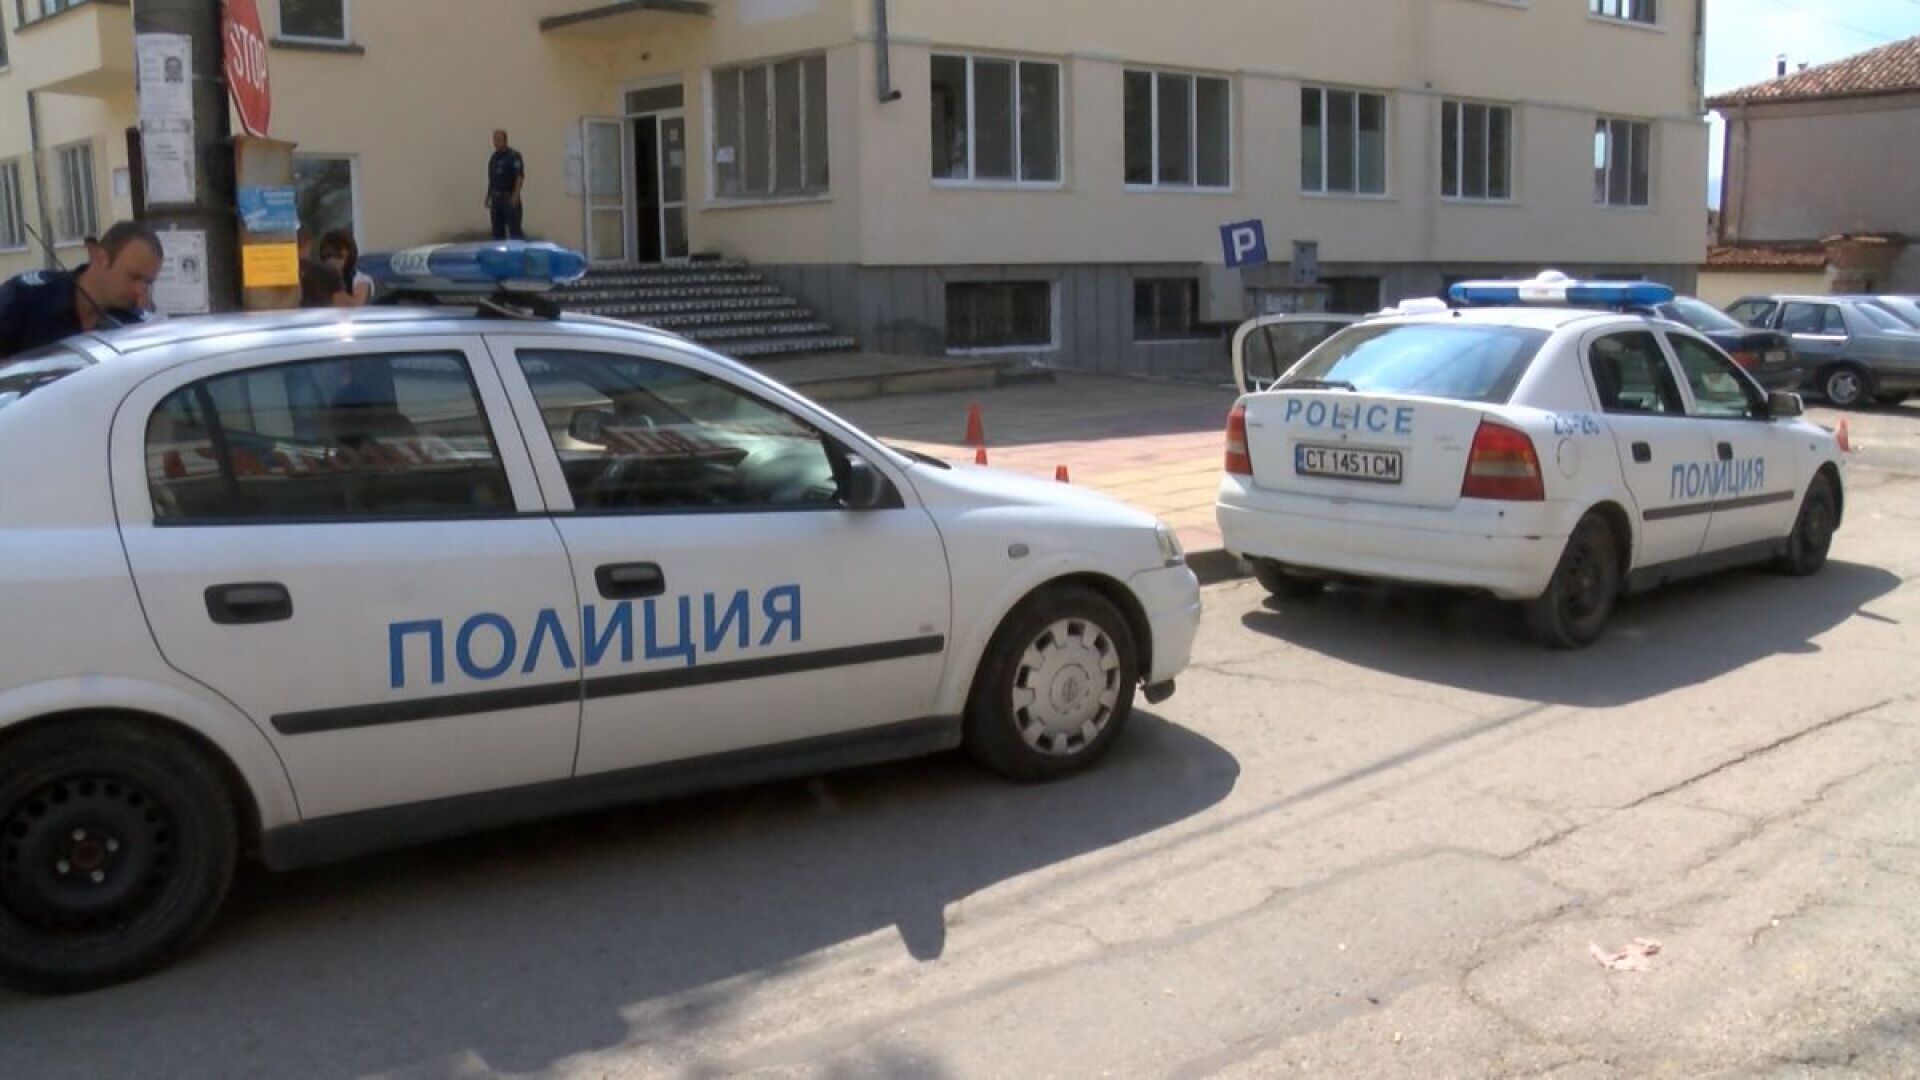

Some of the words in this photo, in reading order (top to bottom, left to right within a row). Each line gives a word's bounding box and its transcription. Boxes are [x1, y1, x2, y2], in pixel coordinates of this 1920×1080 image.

[229, 22, 268, 95] STOP
[1232, 227, 1256, 262] P
[1285, 398, 1415, 434] POLICE
[1333, 452, 1369, 475] 1451
[1671, 457, 1765, 499] ПОЛИЦИЯ
[388, 584, 801, 689] ПОЛИЦИЯ
